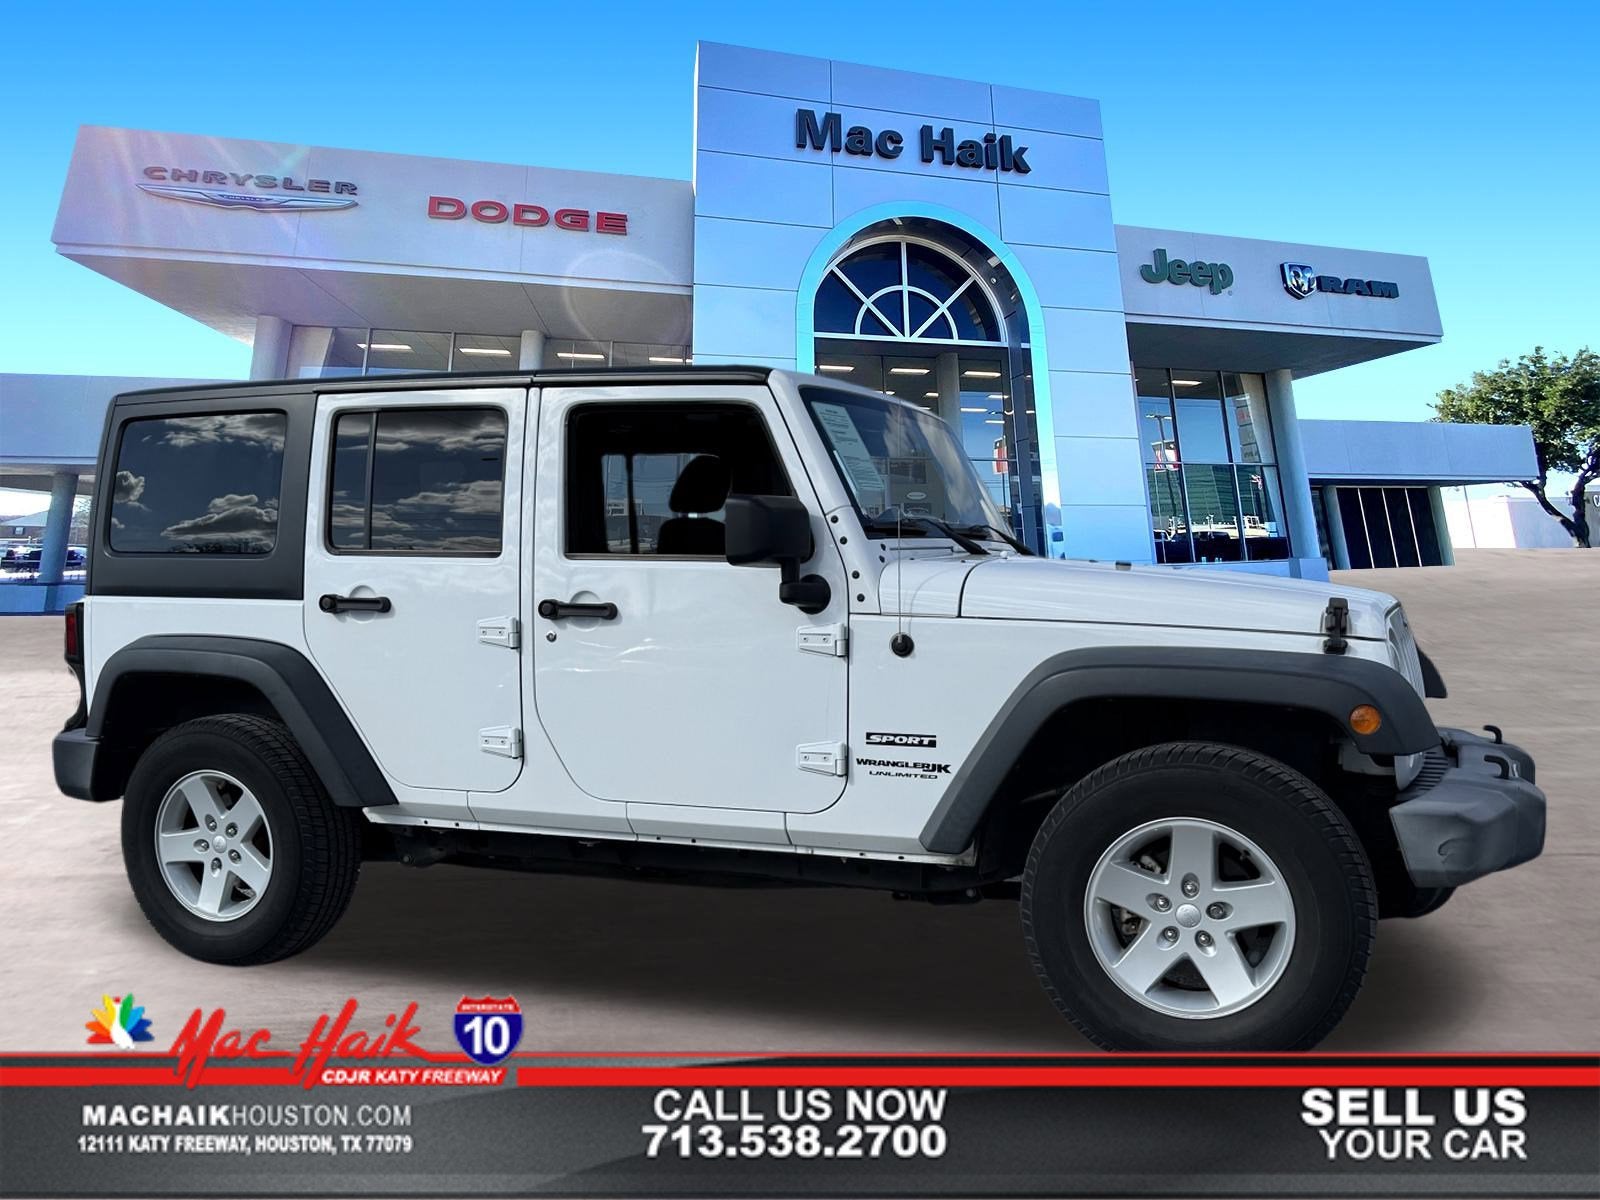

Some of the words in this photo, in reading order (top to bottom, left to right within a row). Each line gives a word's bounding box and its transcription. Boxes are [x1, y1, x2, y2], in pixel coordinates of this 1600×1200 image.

[796, 108, 904, 160] Mac
[920, 124, 1032, 174] Haik
[143, 166, 358, 196] CHRYSLER
[428, 195, 628, 236] DODGE
[1140, 248, 1234, 295] Jeep
[1316, 275, 1399, 299] RAM
[867, 733, 936, 747] SPORT
[869, 770, 938, 779] UNLIMITED
